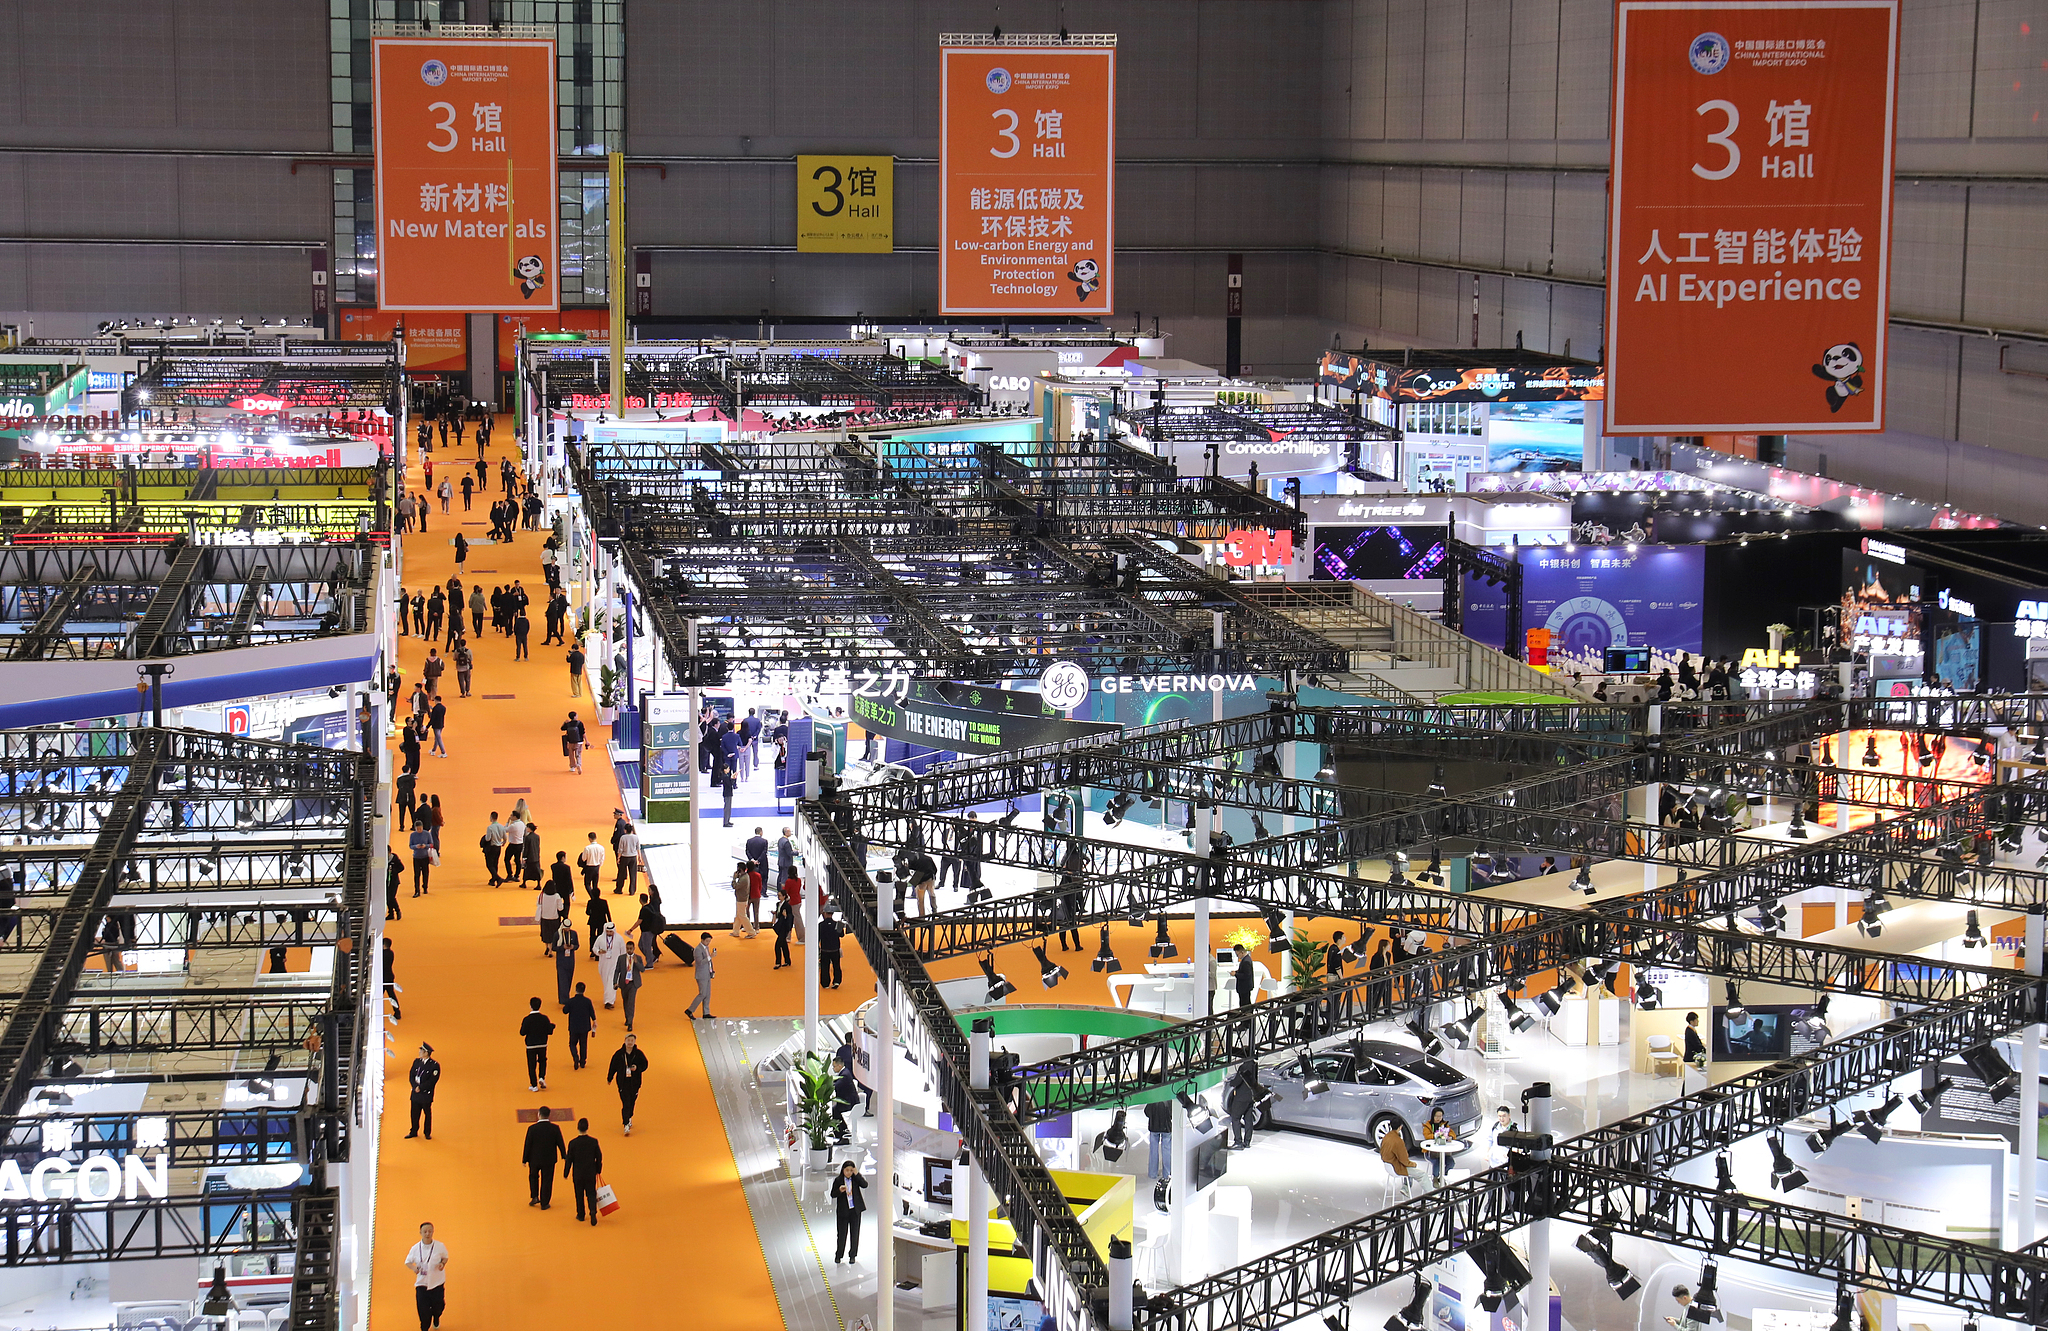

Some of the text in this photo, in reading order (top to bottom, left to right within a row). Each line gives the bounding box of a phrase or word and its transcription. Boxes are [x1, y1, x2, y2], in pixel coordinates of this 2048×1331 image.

[1762, 51, 1826, 59] INTERNATIONAL
[1785, 59, 1808, 67] EXPO
[426, 101, 503, 152] 3 馆
[989, 108, 1063, 158] 3 馆
[471, 137, 506, 152] Hall
[1691, 98, 1812, 181] 3 馆
[1033, 143, 1065, 158] Hall
[1761, 154, 1814, 179] Hall
[420, 182, 515, 214] 新材料
[812, 165, 877, 217] 3 馆
[970, 188, 1085, 210] 能源低碳及
[849, 204, 879, 218] Hall
[390, 218, 547, 238] New Materals
[981, 215, 1073, 238] 环保技术
[954, 240, 1094, 255] Low-carbon Energy and
[1638, 226, 1863, 266] 人工智能体验
[980, 254, 1068, 266] Environmental
[993, 268, 1055, 280] Protection
[990, 283, 1058, 298] Technology
[1635, 271, 1861, 308] AI Experience
[1437, 381, 1516, 391] SCP COPOWER
[1225, 440, 1331, 457] ConocoPhillips
[1224, 529, 1293, 567] 3M
[1539, 558, 1632, 569] 中银科创 智启未来
[1854, 615, 1909, 637] AI+
[1741, 648, 1801, 669] AI+
[1100, 673, 1257, 693] GE VERNOVA
[1739, 669, 1817, 691] 全球合作
[905, 710, 968, 741] THE ENERGY
[969, 721, 1000, 734] TO CHANGE
[969, 732, 1000, 746] THE WORLD
